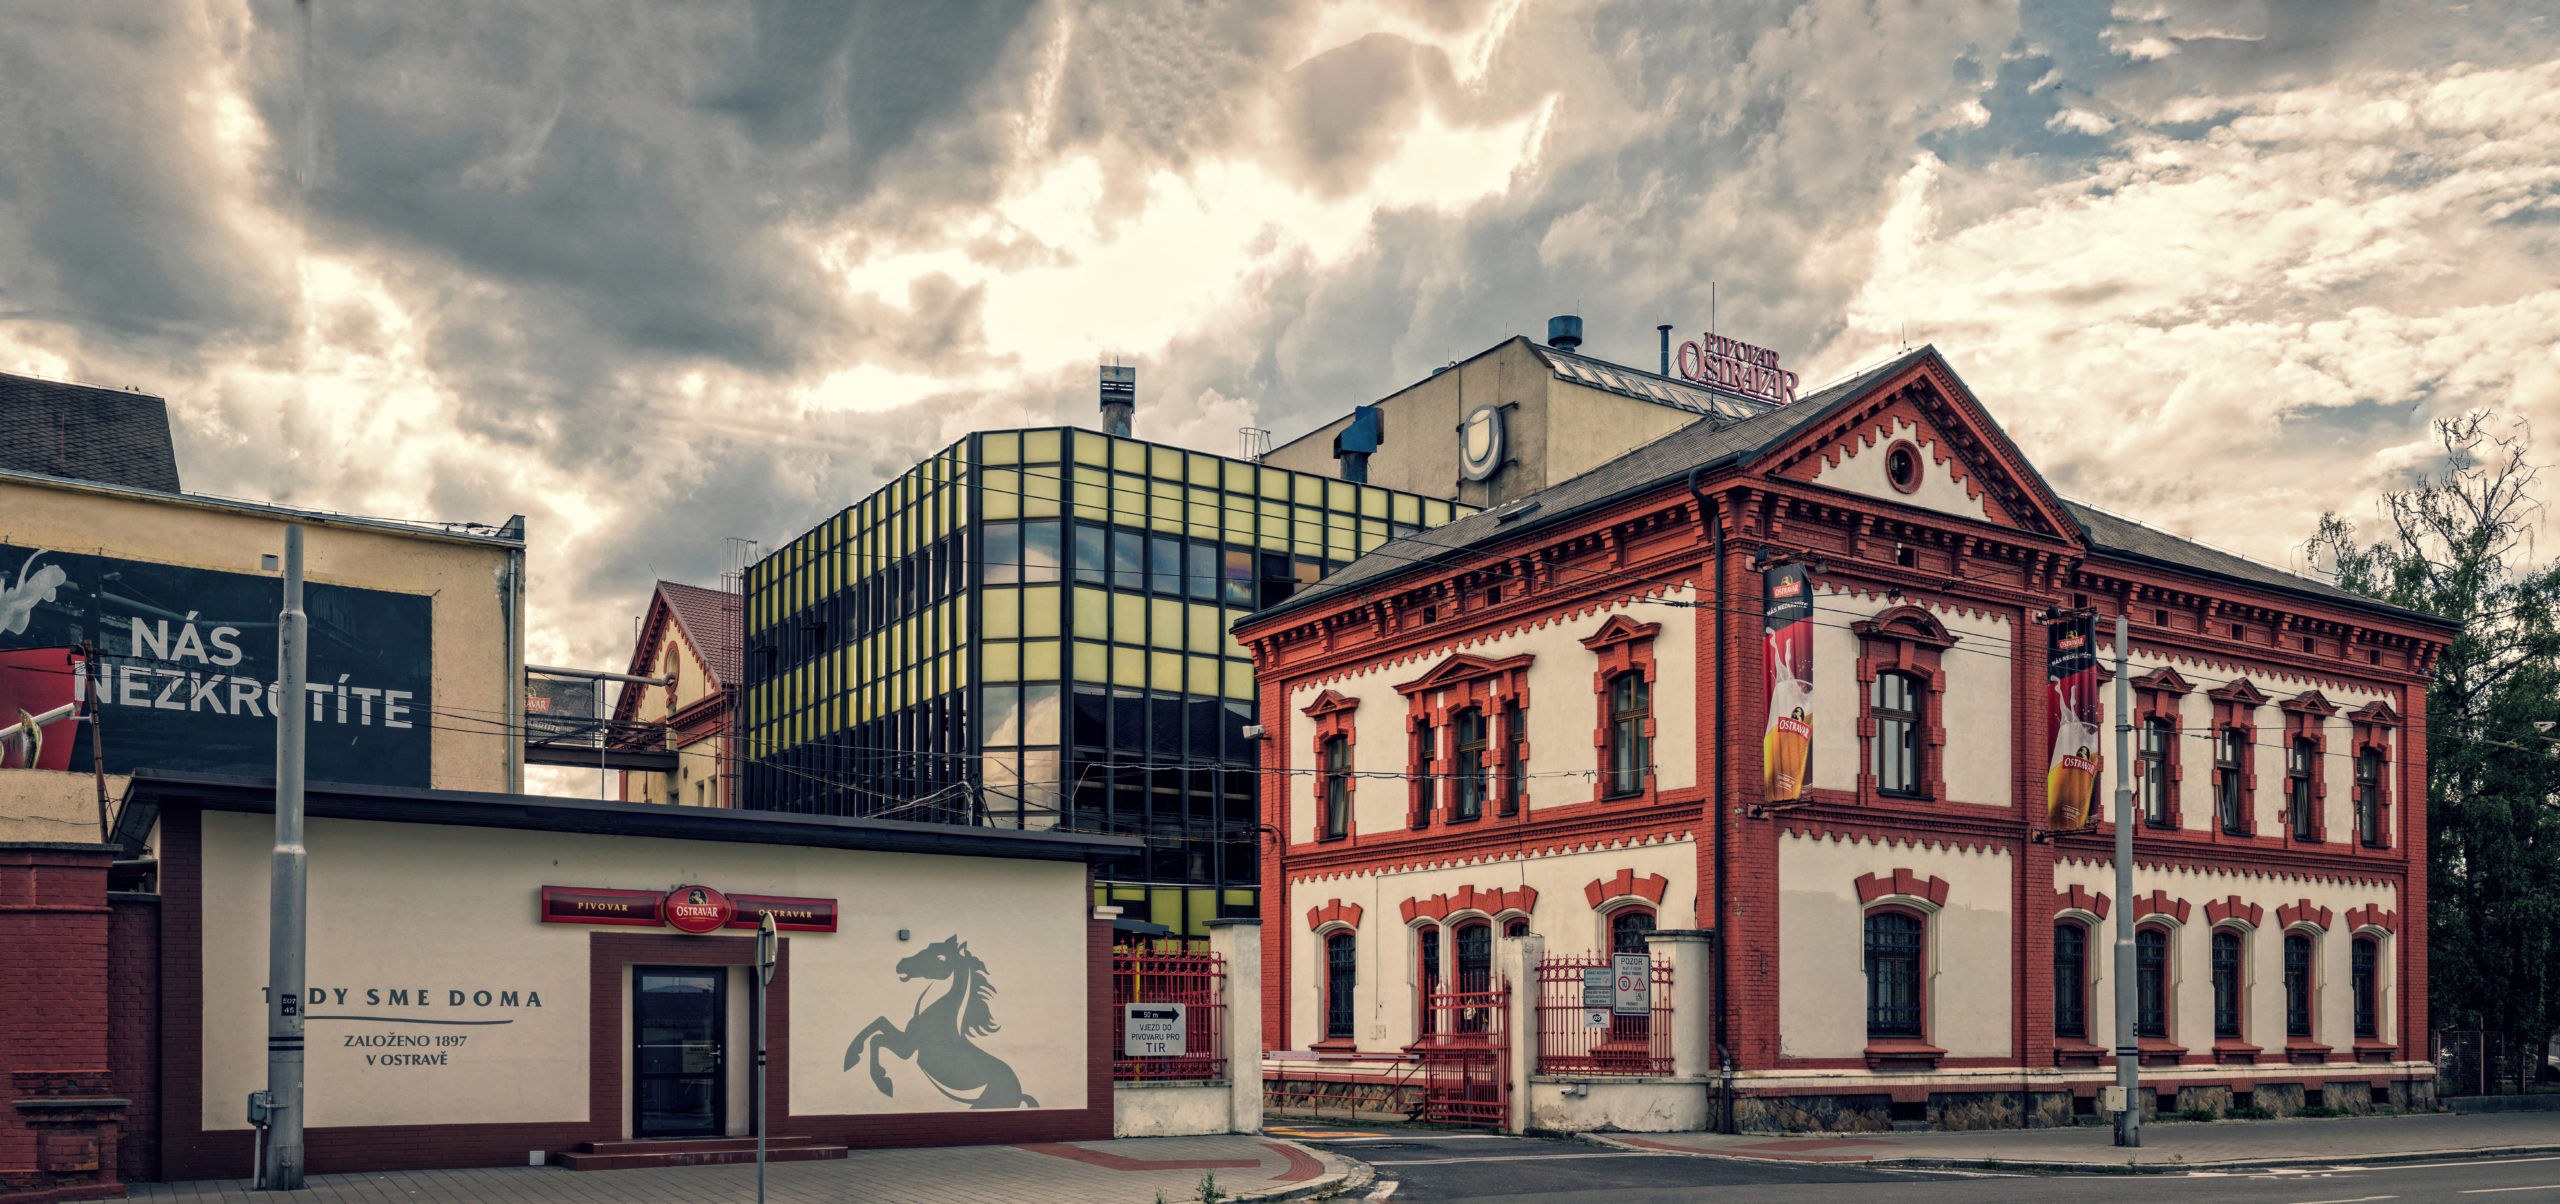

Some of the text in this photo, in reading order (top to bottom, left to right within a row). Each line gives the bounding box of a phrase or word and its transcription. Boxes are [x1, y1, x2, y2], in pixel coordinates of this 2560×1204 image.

[1704, 332, 1780, 370] PIVOVAR
[1678, 340, 1800, 404] OSTRAVAR
[131, 611, 242, 666] NÁS
[1779, 719, 1809, 739] OSTRAVAR
[2064, 757, 2095, 775] OSTRAVAR
[578, 902, 629, 912] PIVOVAR
[676, 905, 718, 918] OSTRAVAR
[758, 908, 812, 919] OTRAVAR
[1620, 957, 1643, 966] POZOR
[261, 986, 542, 1008] TDY SME DOMA
[1139, 1023, 1172, 1031] VJEZD DO
[344, 1032, 467, 1047] ZALOŽENO 1897
[1131, 1033, 1180, 1041] PIVOVARU PRO
[1145, 1042, 1166, 1053] TIR
[366, 1051, 447, 1066] V OSTRAVĚ
